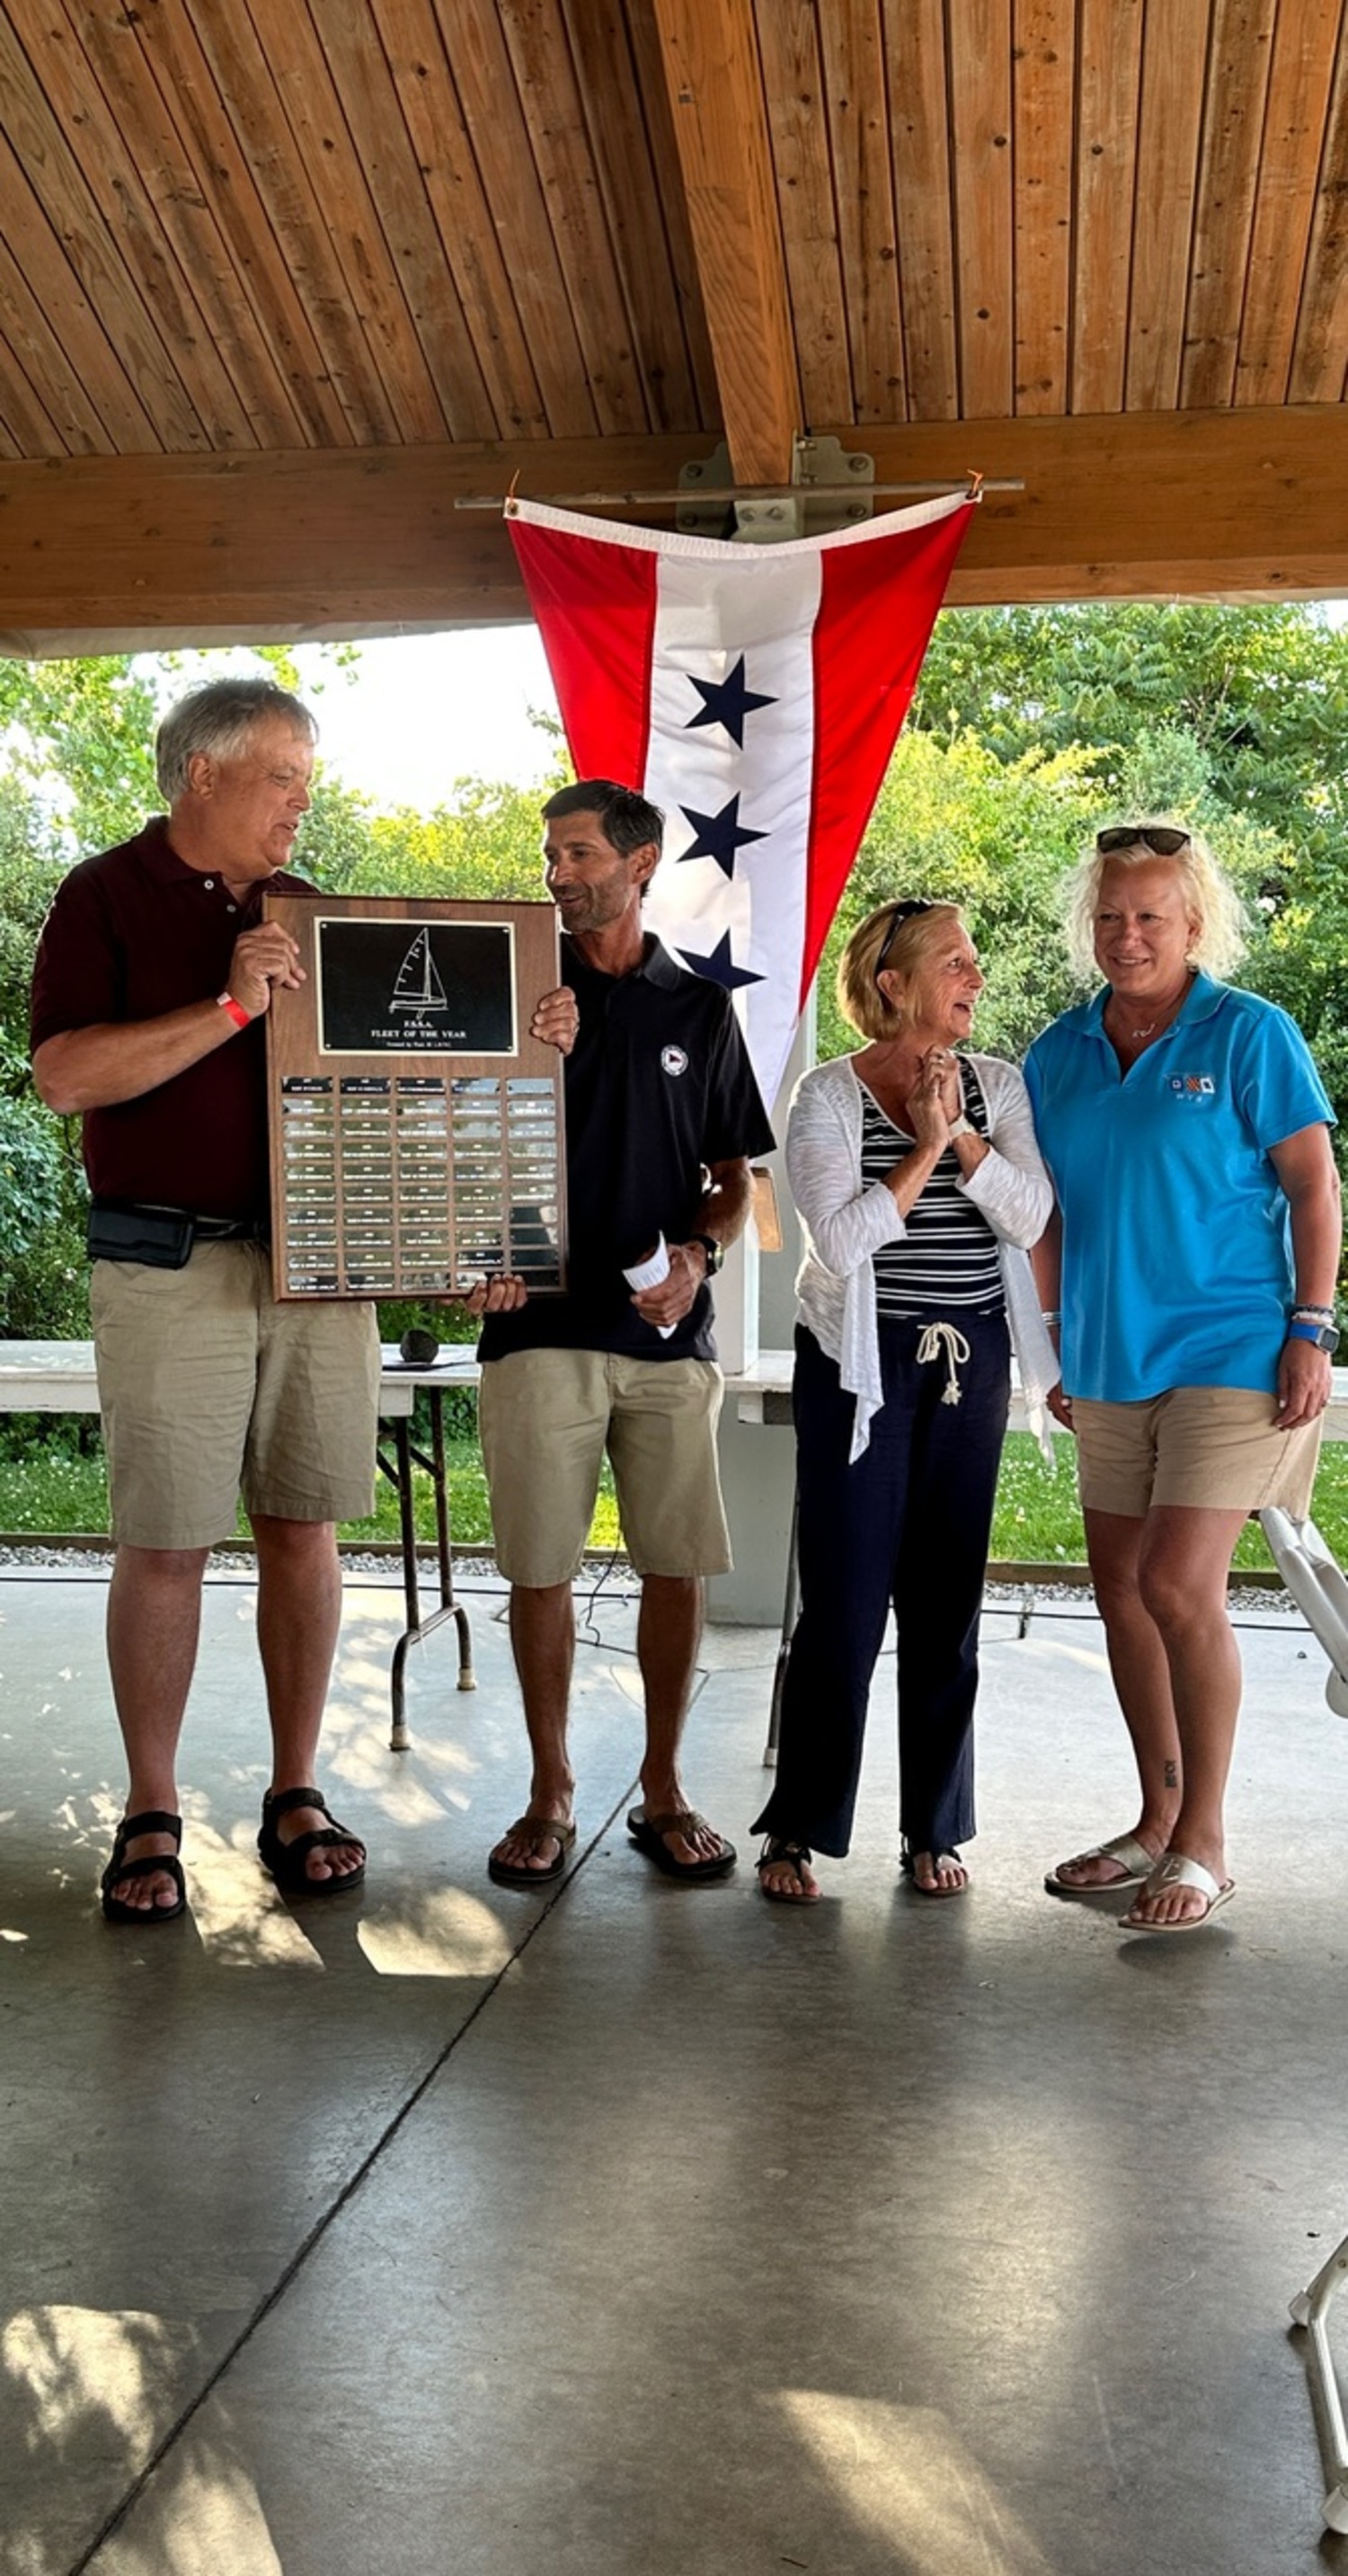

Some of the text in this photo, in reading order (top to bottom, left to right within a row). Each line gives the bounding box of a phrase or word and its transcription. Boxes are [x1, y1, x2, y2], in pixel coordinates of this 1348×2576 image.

[371, 1030, 466, 1039] FLEET OF THE YEAR
